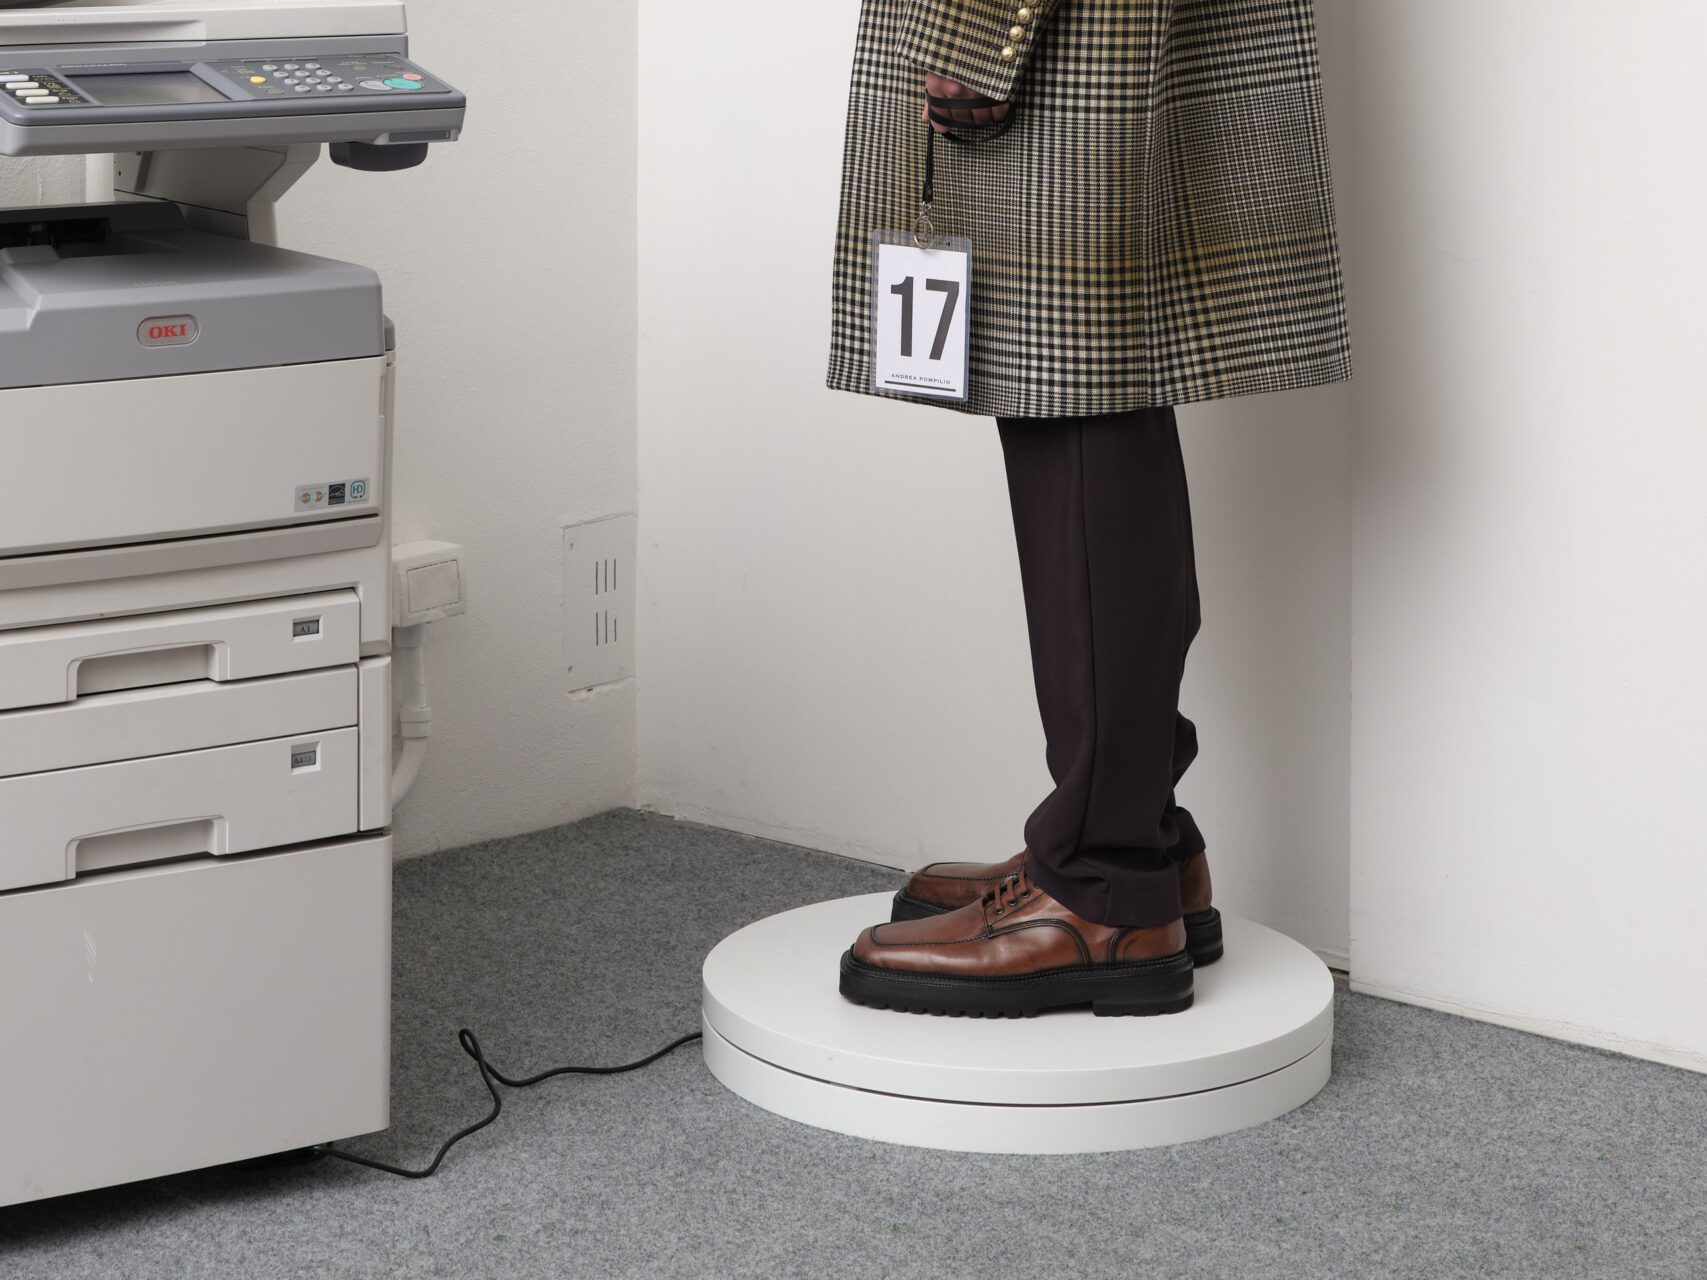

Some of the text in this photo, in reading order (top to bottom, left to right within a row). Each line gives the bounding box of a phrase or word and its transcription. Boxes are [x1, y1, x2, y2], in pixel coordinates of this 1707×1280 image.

[890, 276, 960, 360] 17
[148, 322, 187, 339] OKI
[919, 376, 951, 384] POMPILIO
